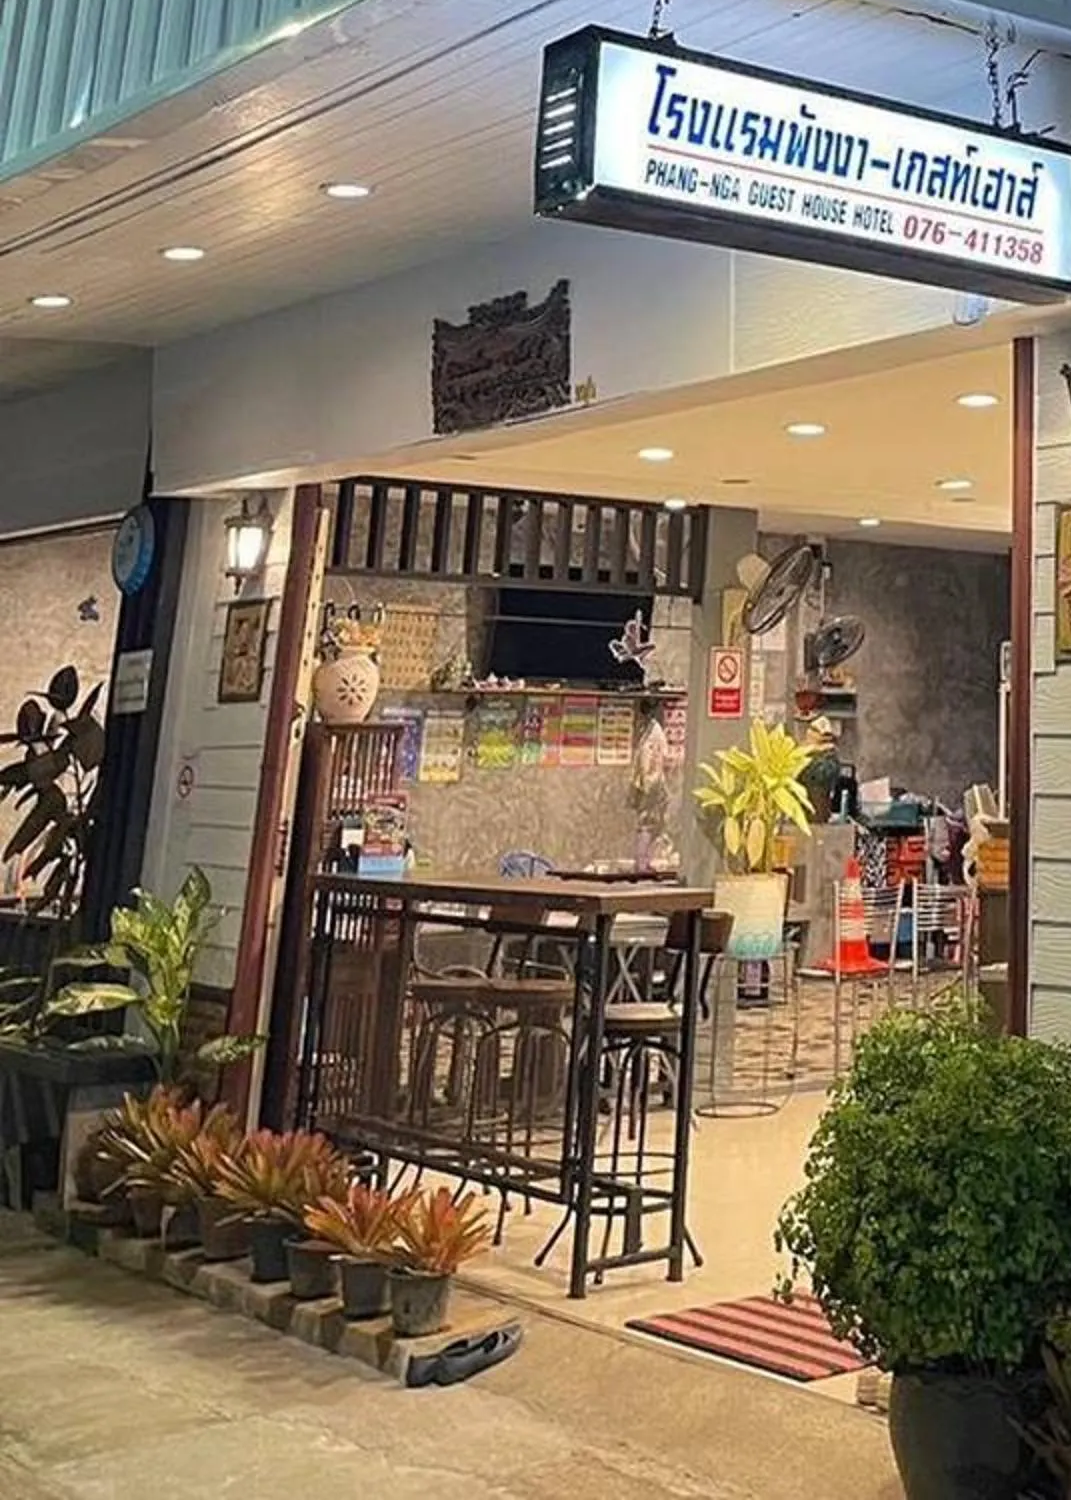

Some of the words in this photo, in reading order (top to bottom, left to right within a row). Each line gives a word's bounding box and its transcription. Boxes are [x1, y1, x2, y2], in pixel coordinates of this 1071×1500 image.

[645, 158, 740, 201] PHANG-NGA
[748, 180, 795, 213] GUEST
[801, 193, 849, 225] HOUSE
[852, 202, 894, 235] HOTEL
[903, 215, 1044, 265] 076-411358
